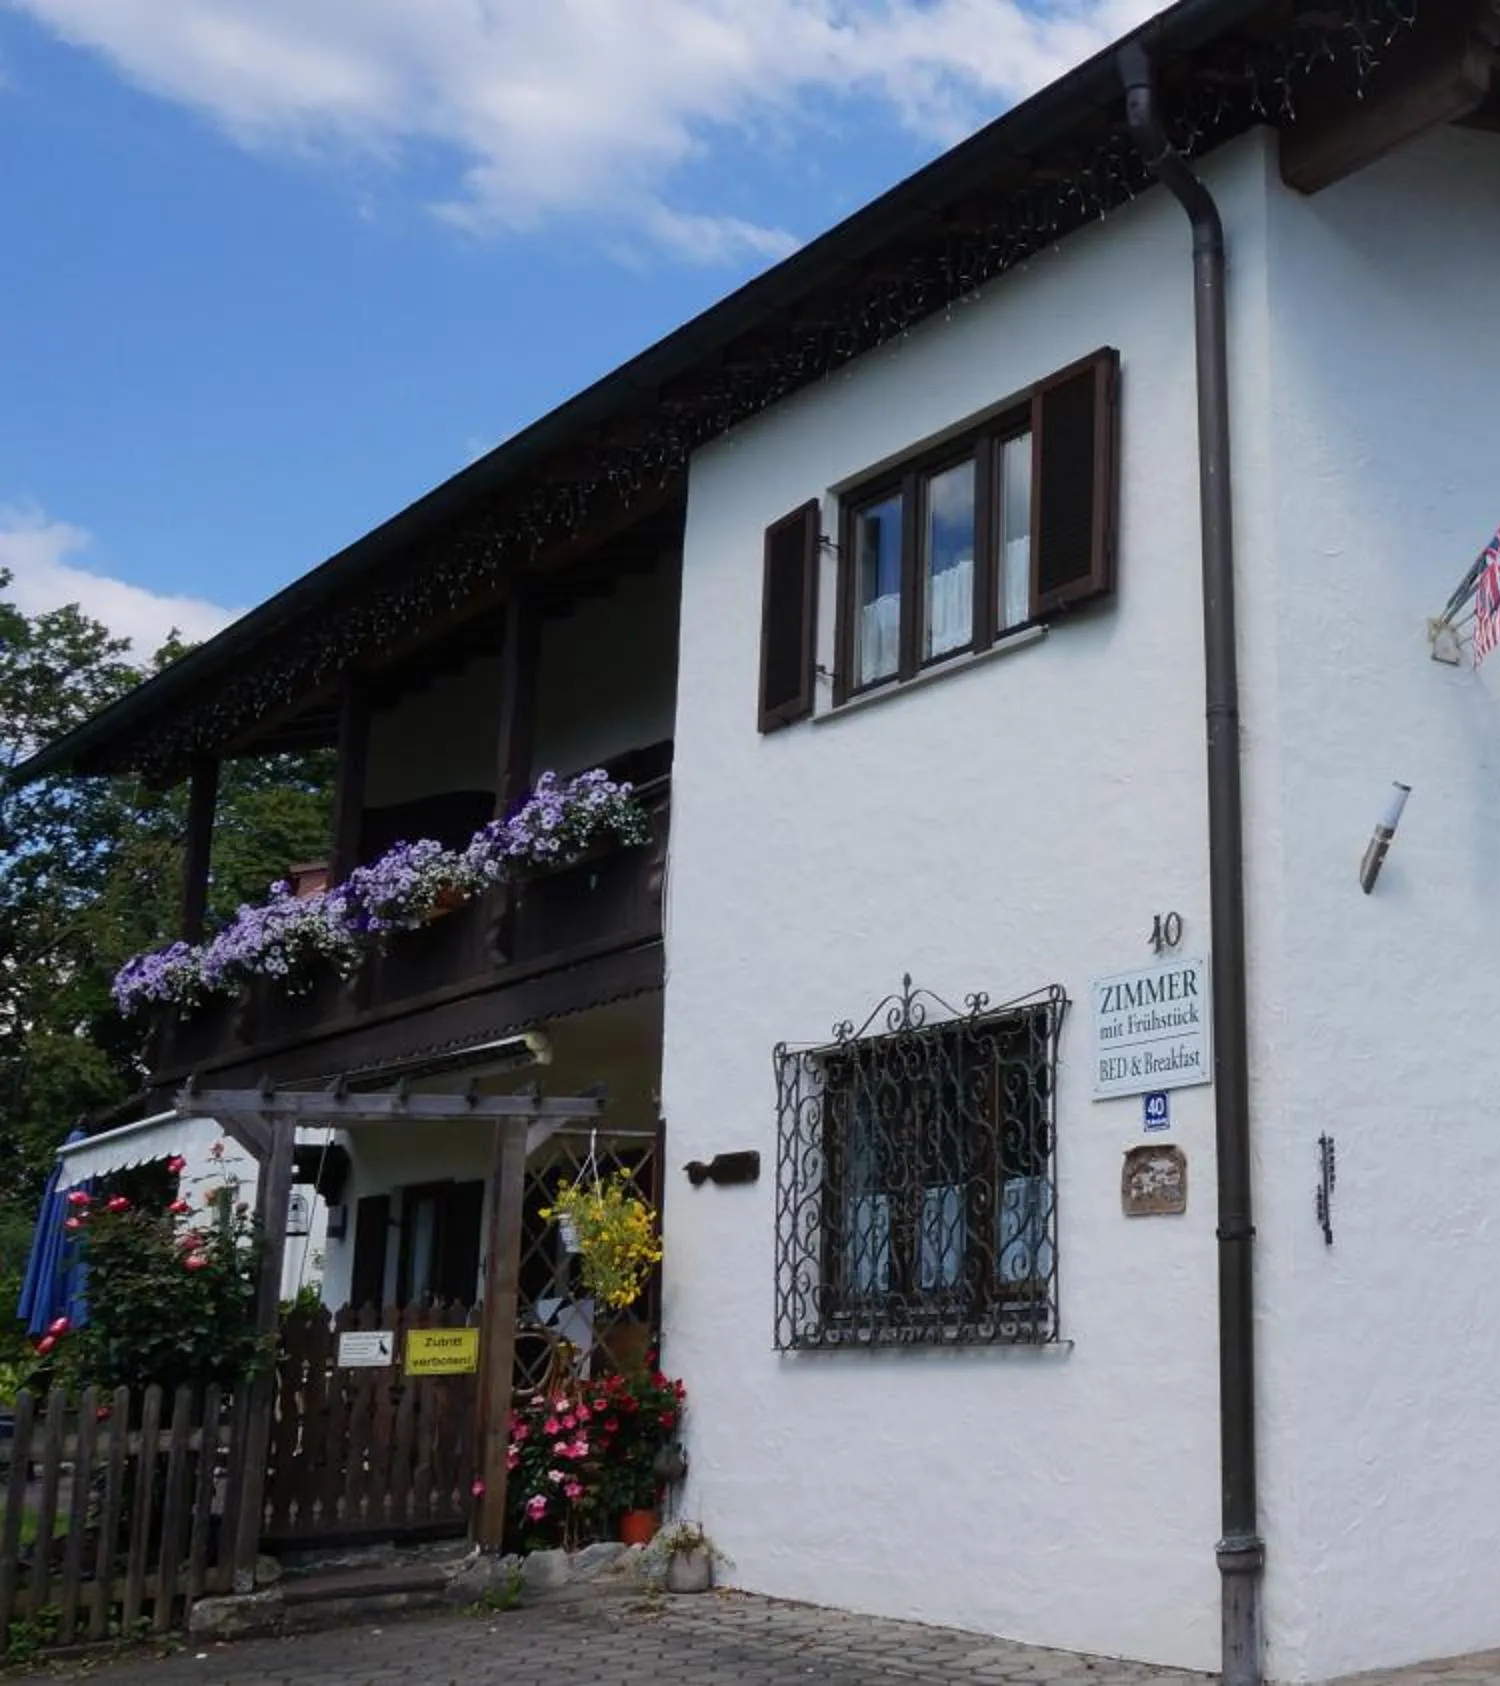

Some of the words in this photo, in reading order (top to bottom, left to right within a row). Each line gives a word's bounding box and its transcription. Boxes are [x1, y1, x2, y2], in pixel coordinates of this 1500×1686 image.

[1100, 969, 1198, 1015] ZIMMER
[1100, 1017, 1124, 1040] mit
[1127, 1003, 1199, 1034] Frühstück
[1100, 1056, 1128, 1081] BED
[1131, 1056, 1143, 1076] &
[1143, 1043, 1200, 1075] Breakfast
[1147, 1097, 1165, 1115] 40
[424, 1336, 463, 1347] Zutritt
